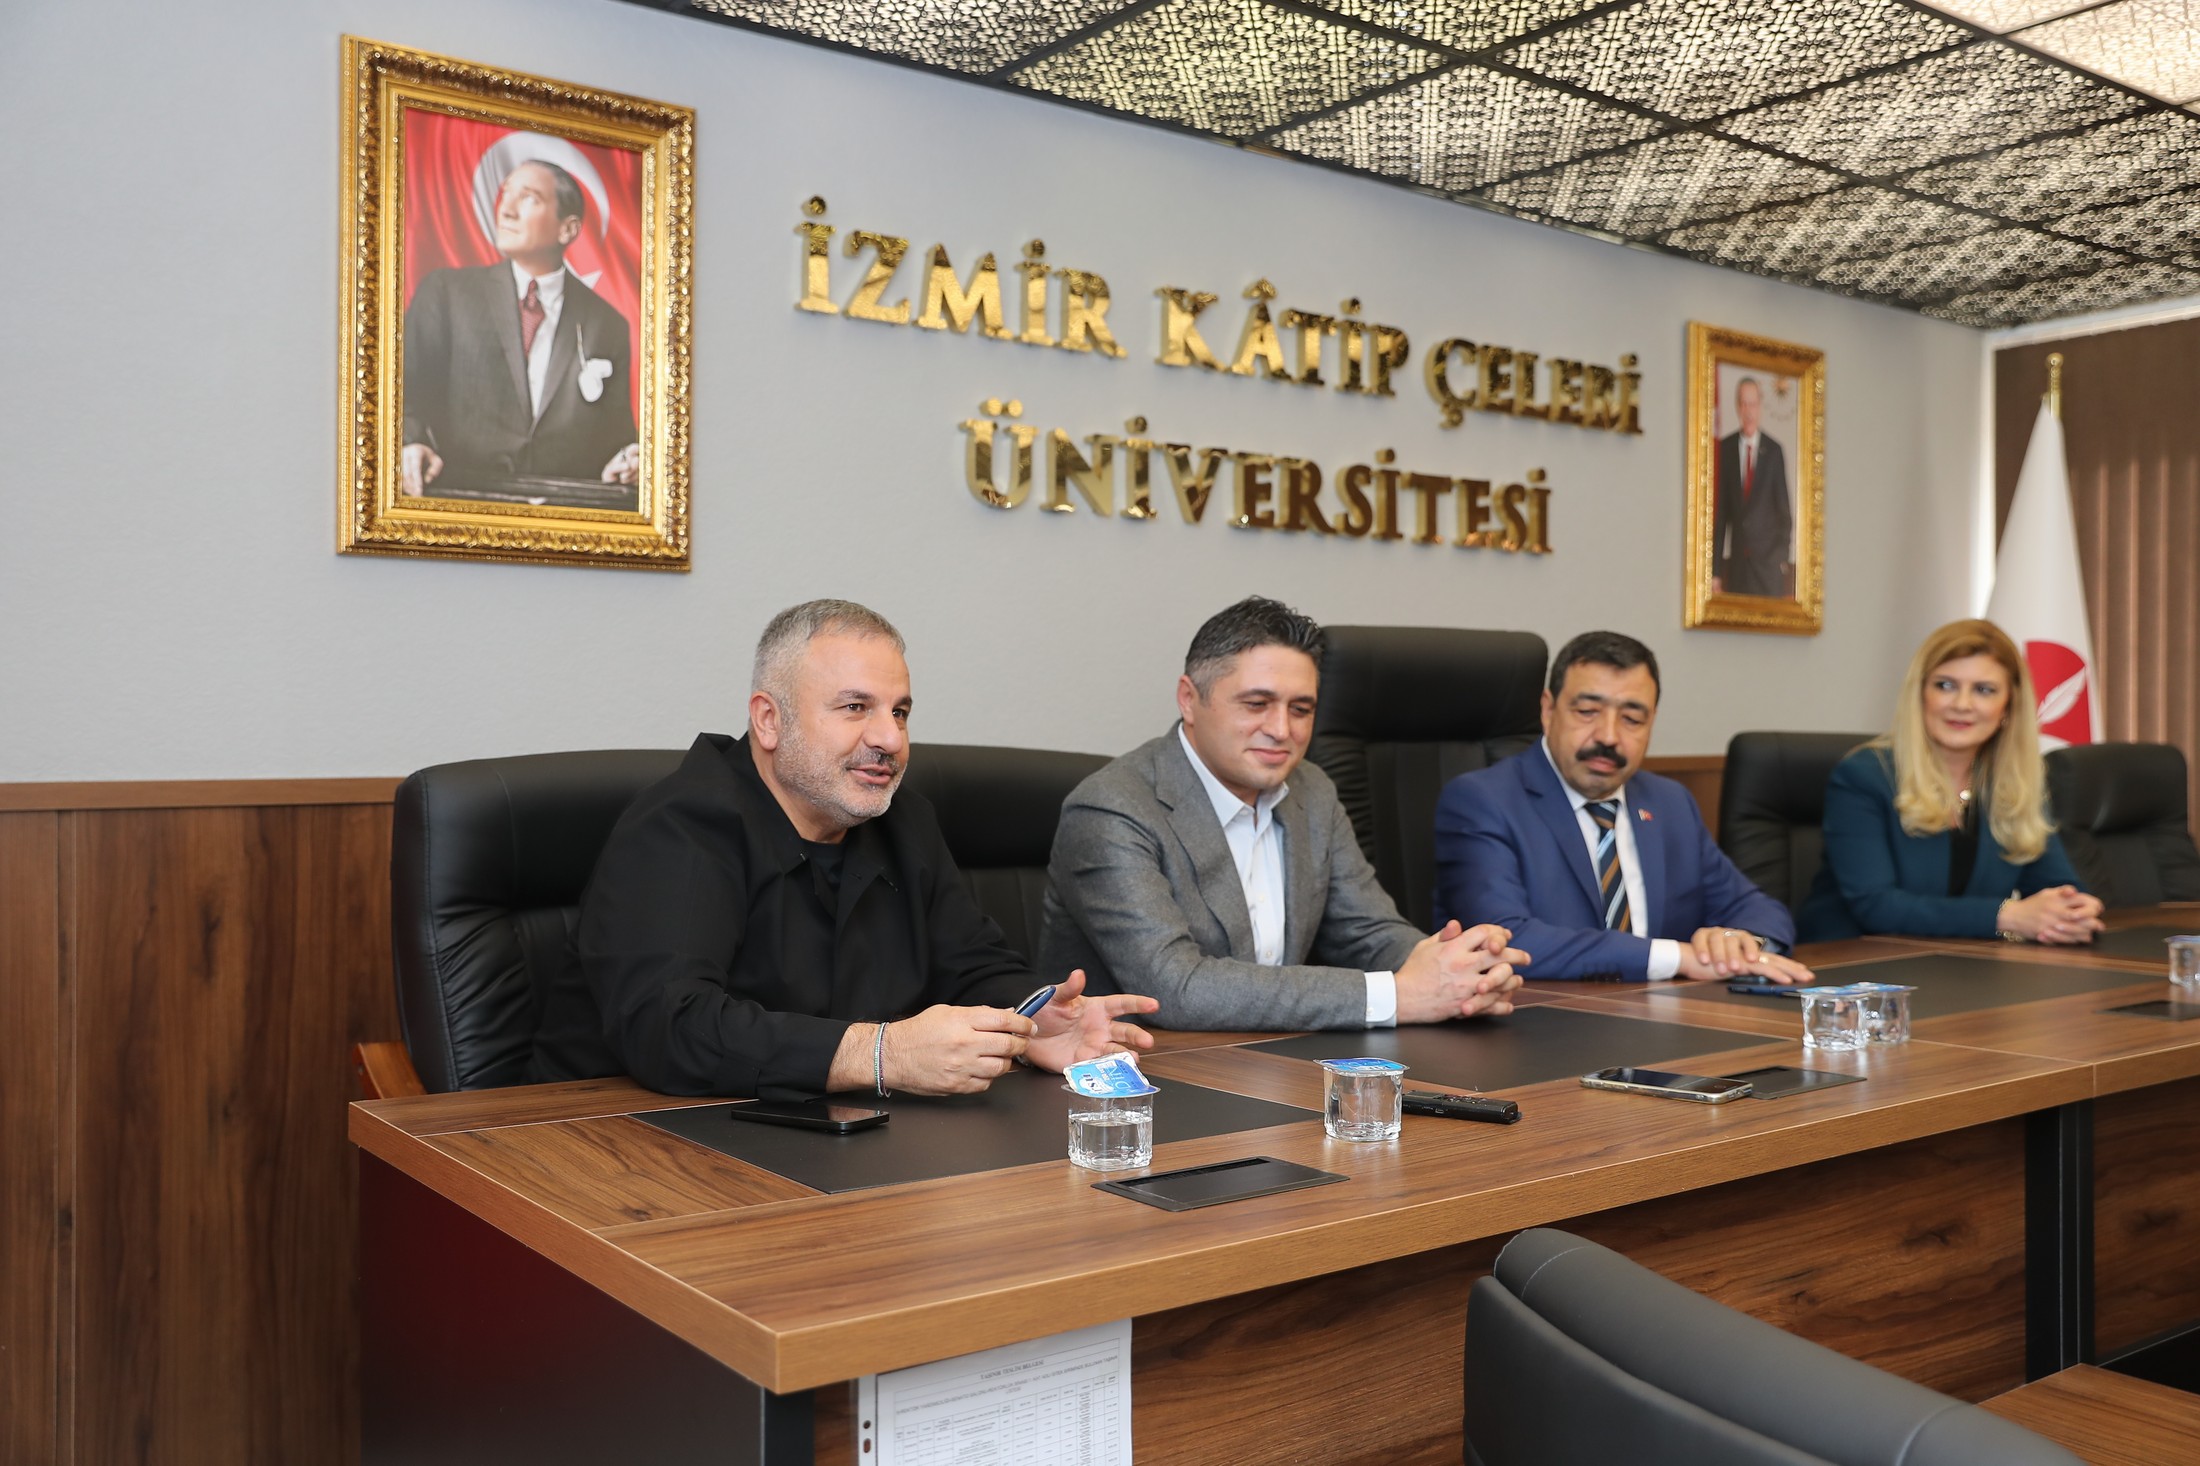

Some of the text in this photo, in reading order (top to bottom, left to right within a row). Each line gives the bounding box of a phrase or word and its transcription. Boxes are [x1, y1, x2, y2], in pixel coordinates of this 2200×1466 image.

[793, 194, 1129, 359] İZMİR
[1153, 276, 1411, 397] KÂTİP
[958, 397, 1553, 555] ÜNİVERSİTESİ
